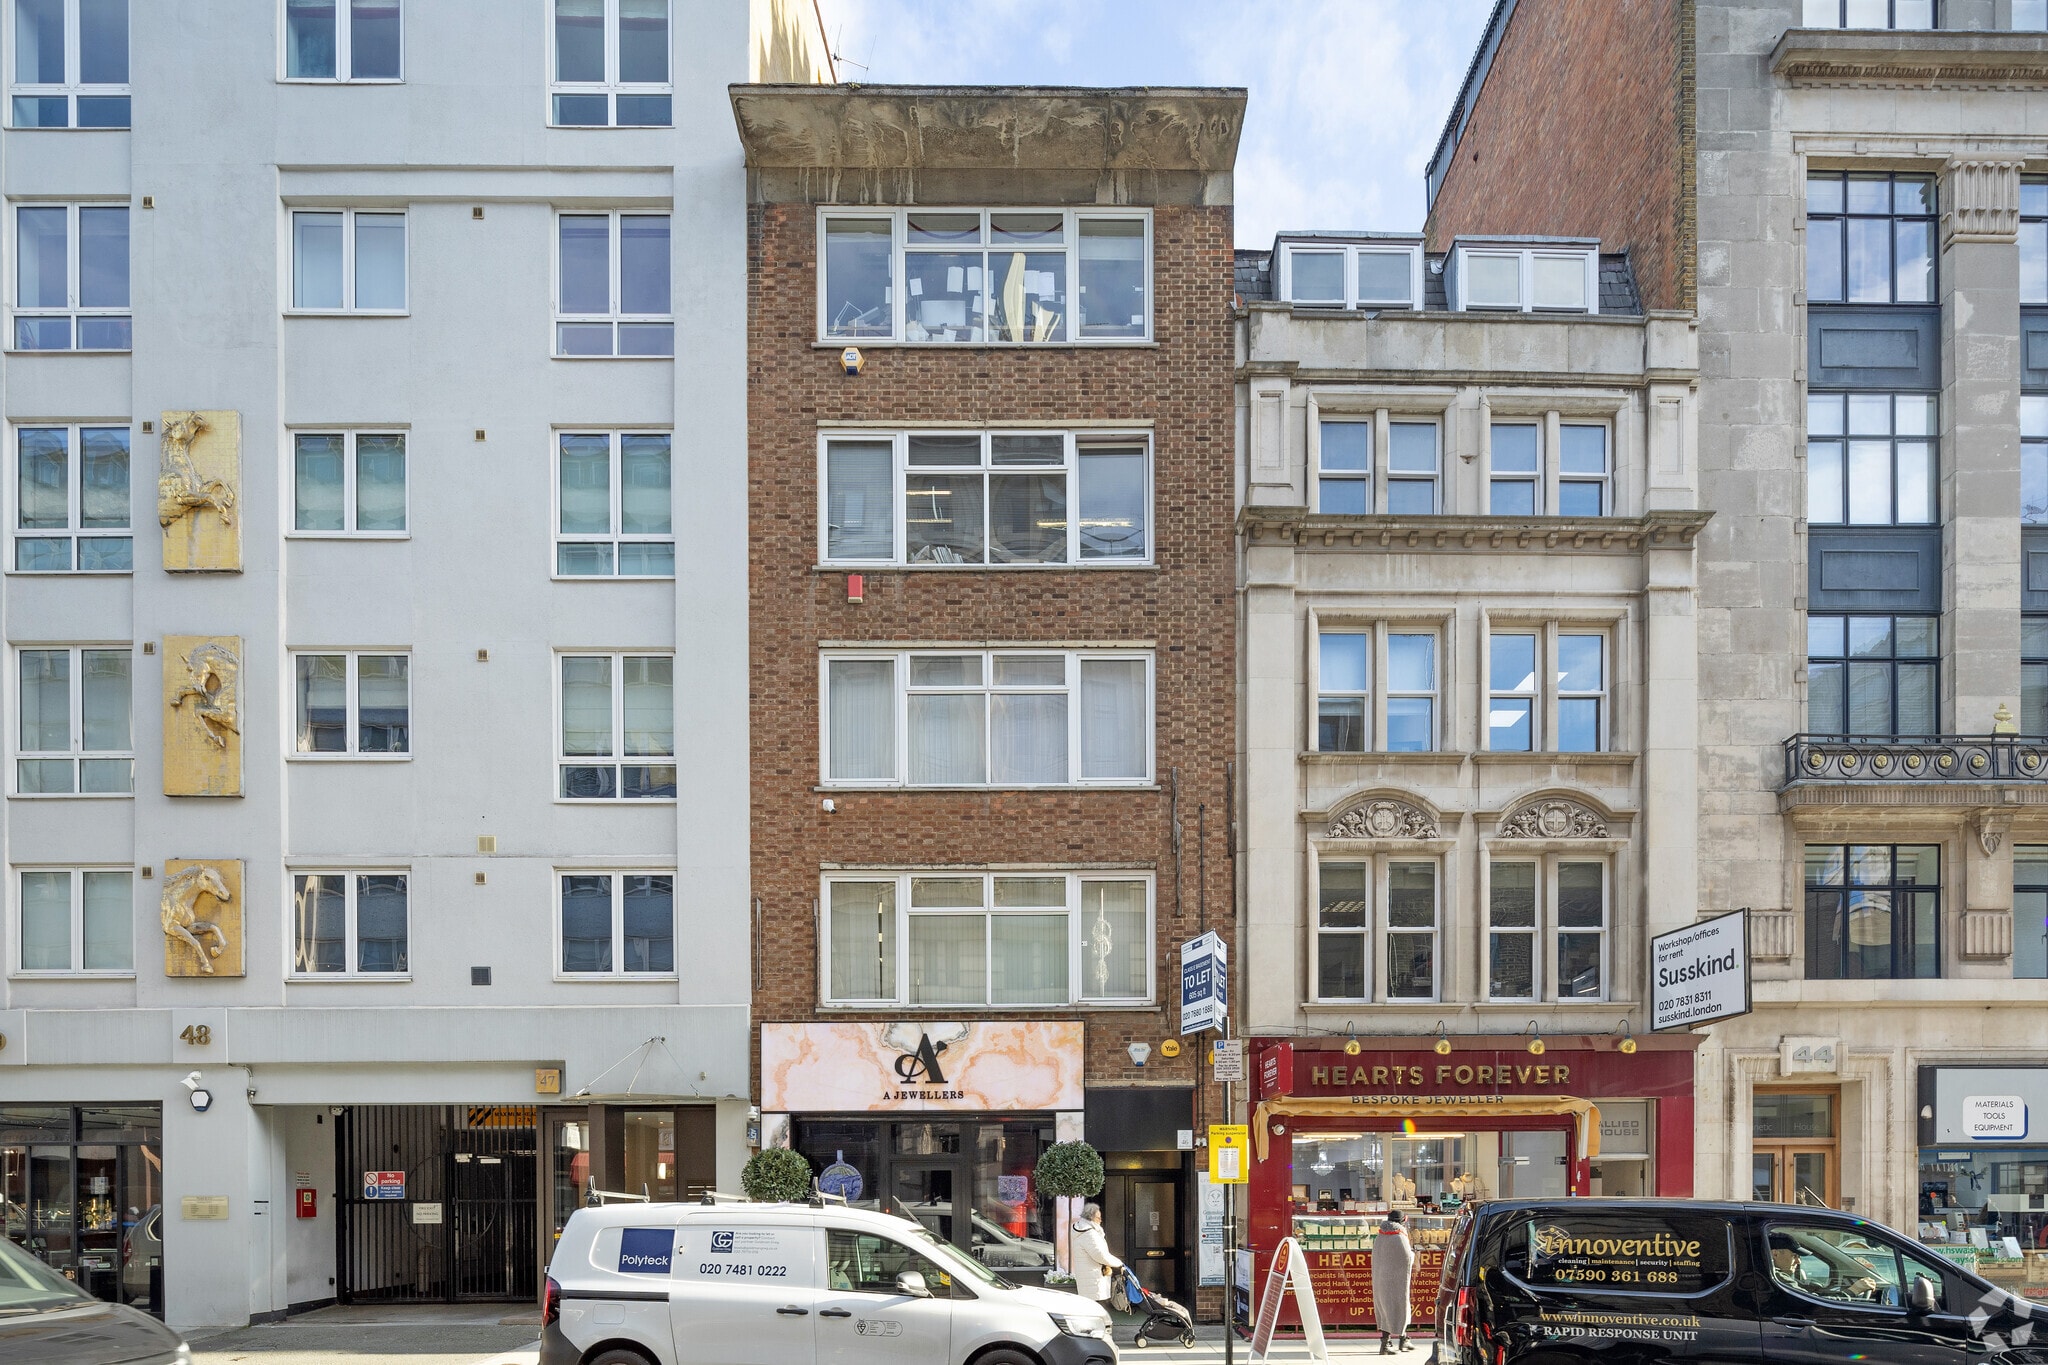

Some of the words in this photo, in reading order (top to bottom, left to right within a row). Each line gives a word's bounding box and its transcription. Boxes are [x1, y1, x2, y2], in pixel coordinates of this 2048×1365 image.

[1658, 927, 1720, 952] Workshop/offices
[1658, 954, 1668, 963] for
[1669, 949, 1684, 960] rent
[1184, 976, 1193, 989] TO
[1197, 968, 1211, 985] LET
[1658, 999, 1674, 1011] 020
[1676, 995, 1692, 1008] 7831
[1694, 990, 1712, 1003] 8311
[1658, 1003, 1722, 1024] susskind.london
[180, 1024, 212, 1046] 48
[1792, 1045, 1834, 1064] 44
[540, 1075, 555, 1087] 47
[1311, 1065, 1424, 1086] HEARTS
[1435, 1065, 1570, 1085] FOREVER
[883, 1091, 891, 1100] A
[894, 1090, 964, 1100] JEWELLERS
[1352, 1095, 1420, 1104] BESPOKE
[1426, 1095, 1504, 1104] JEWELLER
[1545, 1228, 1700, 1258] innoventive
[621, 1254, 669, 1267] Polyteck
[1319, 1254, 1372, 1266] HEAR
[700, 1264, 722, 1275] 020
[725, 1264, 753, 1276] 7481
[757, 1266, 787, 1277] 0222
[1555, 1269, 1606, 1282] 07590
[1611, 1270, 1640, 1282] 361
[1647, 1272, 1678, 1283] 688
[1350, 1307, 1364, 1315] UP
[1540, 1311, 1700, 1328] www.innoventive.co.uk
[1544, 1327, 1585, 1337] RAPID
[1588, 1327, 1659, 1339] RESPONSE
[1663, 1330, 1698, 1341] UNIT
